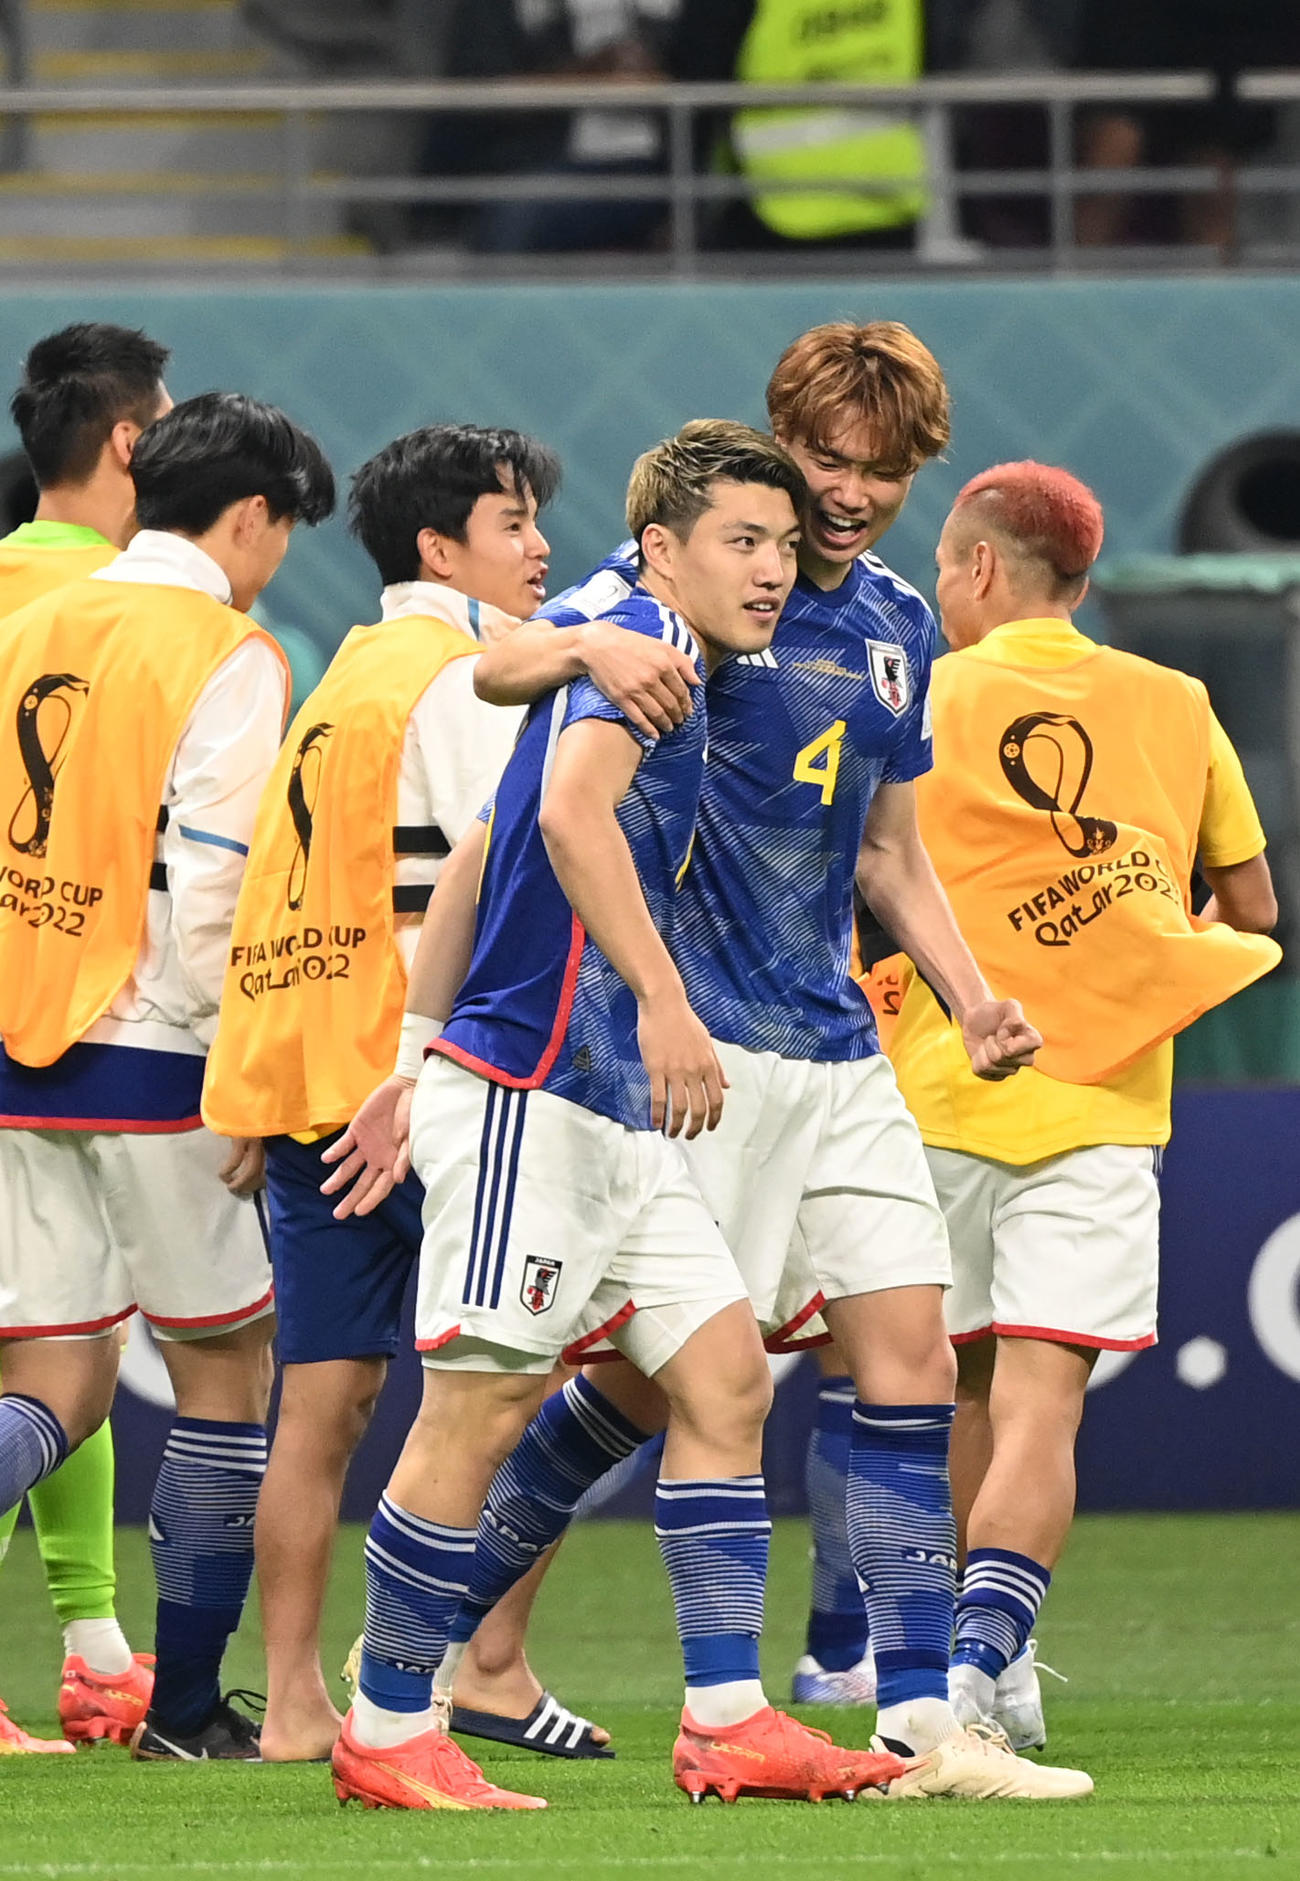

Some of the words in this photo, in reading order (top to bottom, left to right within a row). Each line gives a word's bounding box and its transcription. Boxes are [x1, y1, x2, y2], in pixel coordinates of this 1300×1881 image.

[792, 719, 847, 806] 4
[60, 881, 103, 907] CUP
[1007, 886, 1066, 932] FIFA
[1058, 850, 1150, 897] WORLD
